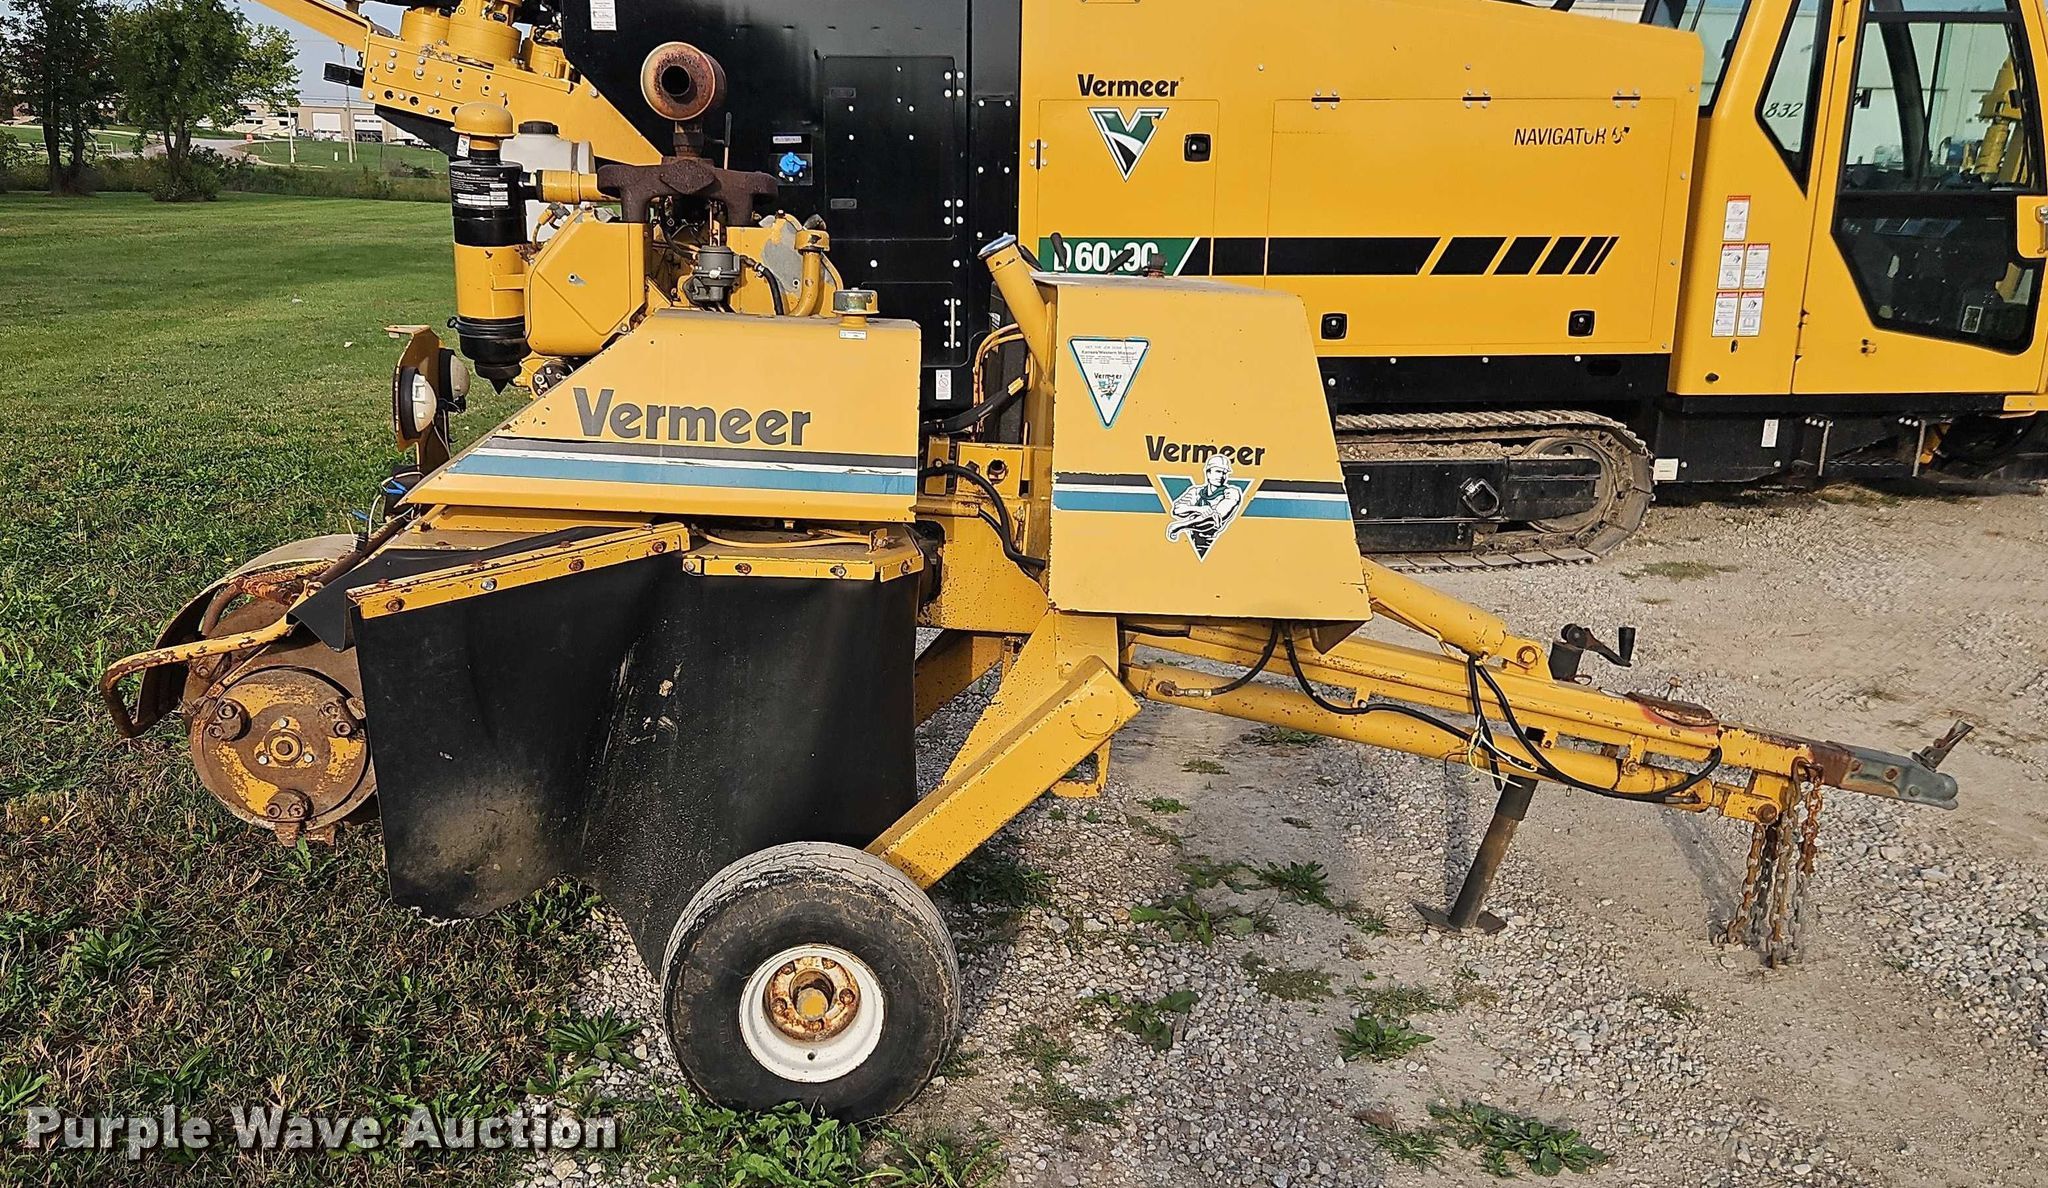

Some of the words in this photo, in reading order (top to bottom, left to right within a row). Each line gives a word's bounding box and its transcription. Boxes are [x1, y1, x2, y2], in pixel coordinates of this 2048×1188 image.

[1077, 74, 1179, 97] Vermeer
[1765, 102, 1803, 118] 832
[573, 387, 811, 446] Vermeer
[1145, 435, 1265, 466] Vermeer
